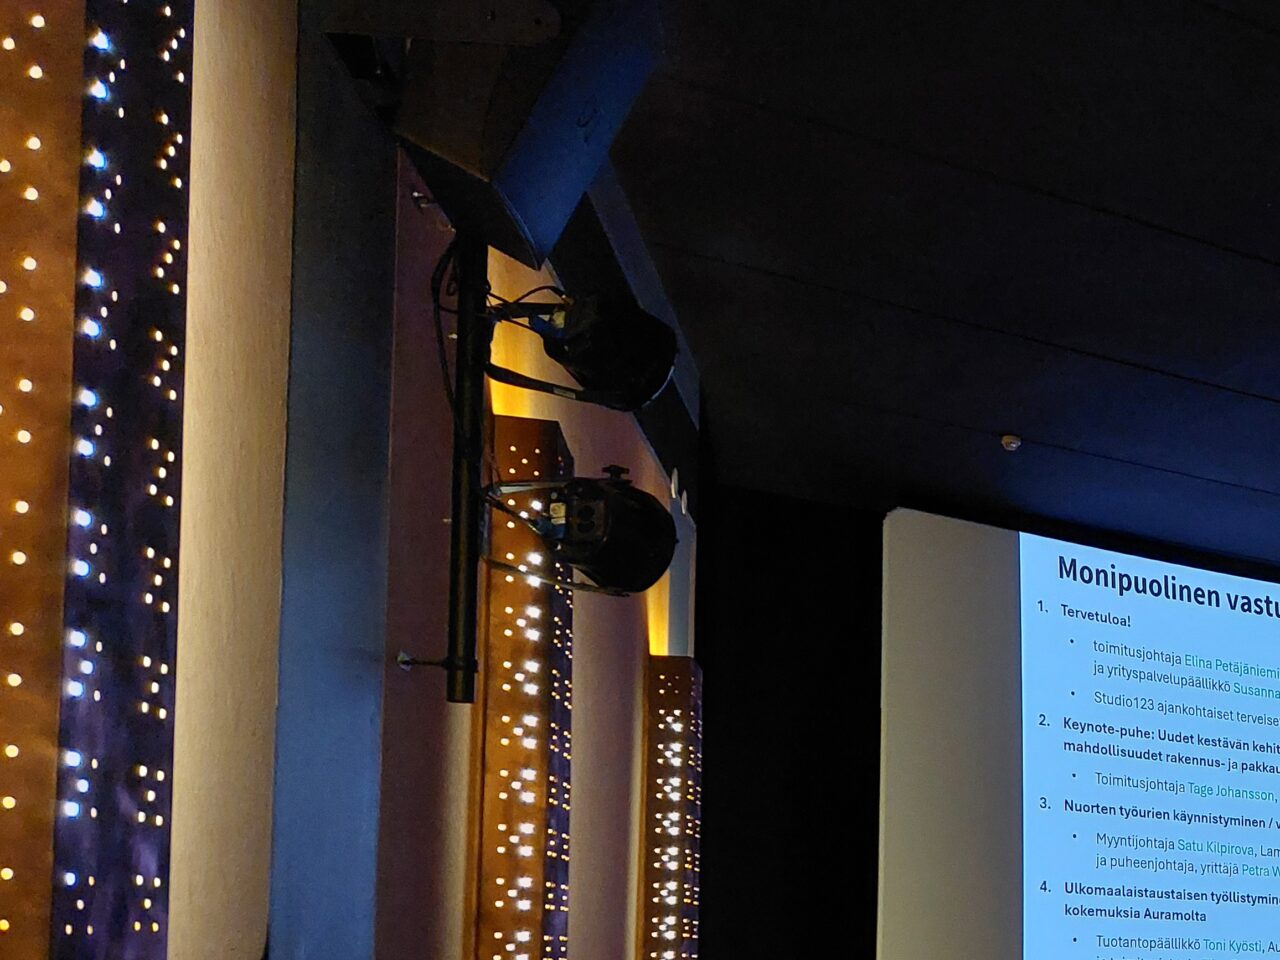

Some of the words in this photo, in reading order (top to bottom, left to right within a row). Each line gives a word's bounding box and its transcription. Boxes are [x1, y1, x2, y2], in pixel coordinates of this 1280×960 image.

[1058, 555, 1220, 608] Monipuolinen
[1037, 600, 1048, 613] 1.
[1060, 603, 1131, 628] Tervetuloa!
[1093, 640, 1182, 667] toimitusjohtaja
[1184, 654, 1212, 669] Elina
[1093, 660, 1104, 676] ja
[1106, 663, 1231, 692] yrityspalvelupäällikkö
[1233, 682, 1280, 699] Susanna
[1094, 691, 1155, 711] Studio123
[1157, 700, 1234, 722] ajankohtaiset
[1038, 713, 1050, 727] 2.
[1063, 716, 1155, 740] Keynote-puhe:
[1158, 728, 1194, 745] Uudet
[1197, 733, 1250, 751] kestävän
[1064, 740, 1163, 762] mahdollisuudet
[1166, 752, 1226, 768] rakennus-
[1227, 757, 1238, 772] ja
[1095, 771, 1185, 795] Toimitusjohtaja
[1187, 781, 1214, 798] Tage
[1216, 785, 1278, 803] Johansson,
[1039, 796, 1051, 810] 3.
[1064, 799, 1116, 816] Nuorten
[1118, 805, 1170, 821] työurien
[1173, 809, 1266, 829] käynnistyminen
[1096, 832, 1175, 852] Myyntijohtaja
[1177, 838, 1203, 852] Satu
[1206, 841, 1258, 858] Kilpirova,
[1096, 853, 1107, 869] ja
[1110, 855, 1198, 875] puheenjohtaja,
[1200, 862, 1239, 877] yrittäjä
[1242, 863, 1270, 877] Petra
[1039, 880, 1052, 893] 4.
[1064, 882, 1208, 901] Ulkomaalaistaustaisen
[1064, 903, 1140, 919] kokemuksia
[1143, 907, 1206, 922] Auramolta
[1096, 934, 1201, 952] Tuotantopäällikkö
[1203, 938, 1226, 951] Toni
[1229, 940, 1265, 954] Kyösti,
